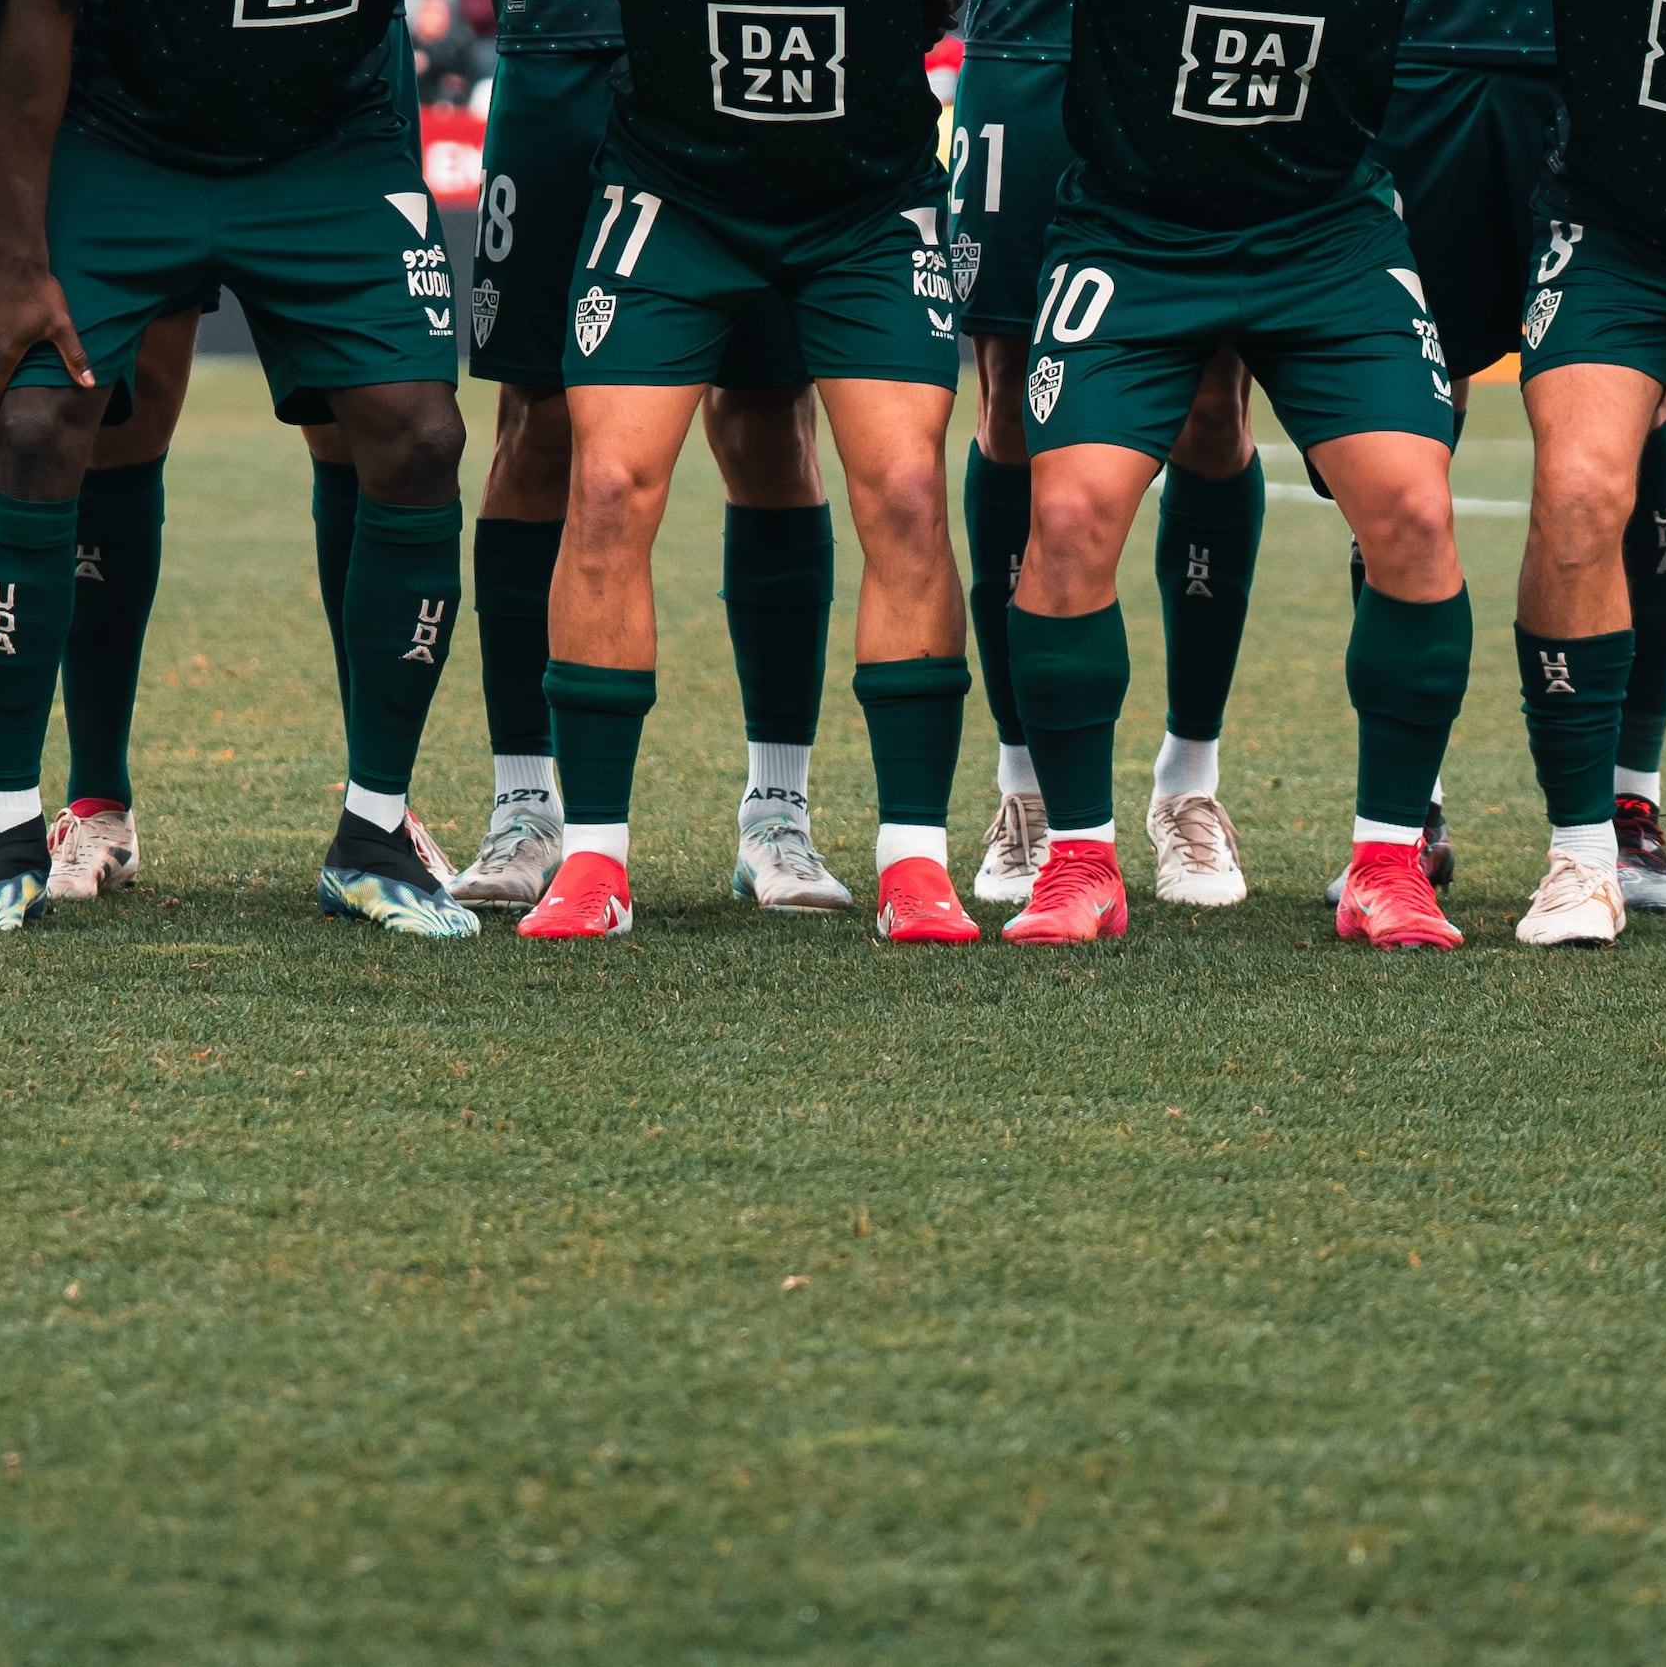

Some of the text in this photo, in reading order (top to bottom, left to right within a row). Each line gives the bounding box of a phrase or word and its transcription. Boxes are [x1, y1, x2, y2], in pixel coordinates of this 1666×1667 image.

[742, 25, 816, 61] DA
[1214, 29, 1286, 67] DA
[743, 68, 813, 103] ZN
[1207, 72, 1280, 107] ZN
[950, 124, 1005, 214] 21
[474, 167, 517, 262] 18
[585, 185, 663, 277] 11
[407, 271, 450, 298] KUDU
[913, 271, 954, 303] KUDU
[1033, 263, 1115, 345] 10
[1188, 544, 1212, 597] UDA
[399, 599, 444, 664] UDA
[1540, 652, 1576, 693] UDA
[494, 789, 549, 809] R27
